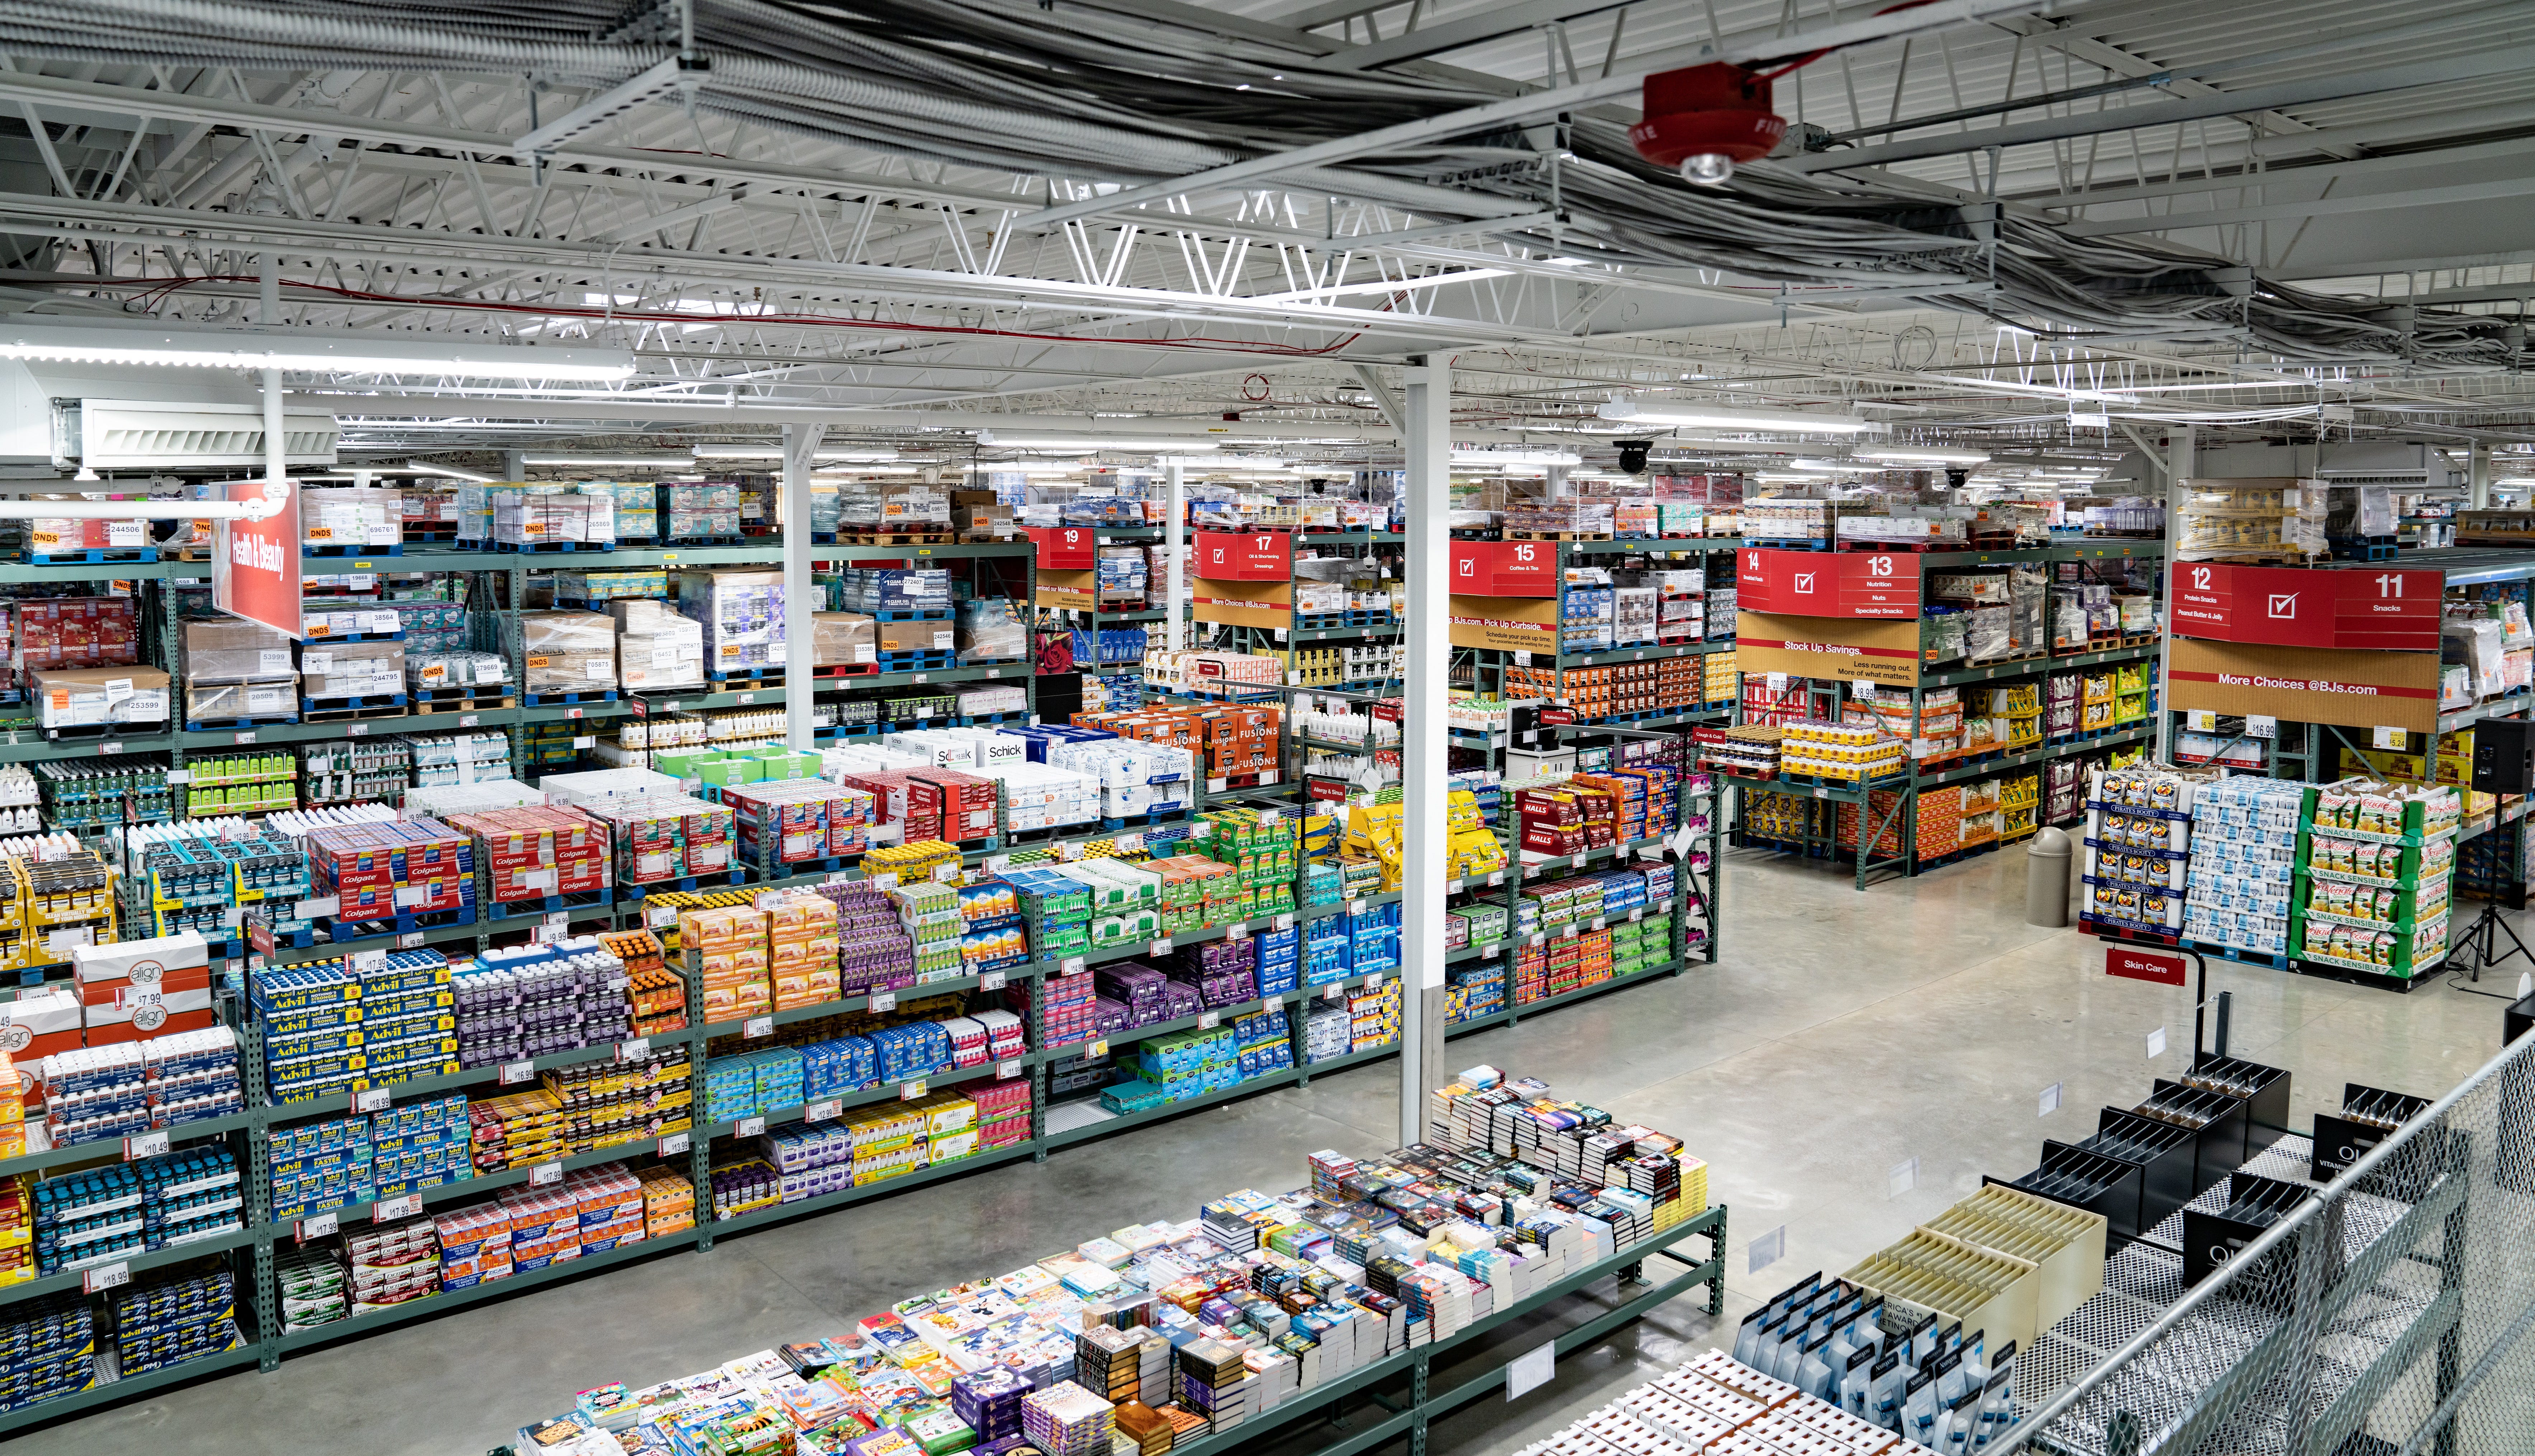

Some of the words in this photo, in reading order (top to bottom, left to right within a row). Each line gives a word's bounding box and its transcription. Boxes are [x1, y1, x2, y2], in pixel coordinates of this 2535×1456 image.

[34, 533, 57, 542] DNDS
[1064, 530, 1078, 543] 19
[1256, 536, 1272, 550] 17
[232, 532, 252, 566] Health
[253, 534, 259, 568] &
[259, 535, 284, 581] Beauty
[1514, 545, 1534, 561] 15
[1748, 552, 1759, 570] 14
[1867, 556, 1892, 576] 13
[2191, 567, 2210, 590] 12
[2376, 574, 2402, 598] 11
[1454, 616, 1482, 626] BJs.com.
[1500, 621, 1509, 629] Up
[1511, 621, 1542, 630] Curbside.
[1784, 641, 1809, 651] Stock
[1811, 643, 1823, 654] Up
[1825, 644, 1862, 656] Savings.
[1519, 656, 1530, 665] $20.99
[1772, 680, 1786, 690] $20.99
[2219, 674, 2250, 686] More
[2254, 676, 2305, 689] Choices
[2309, 680, 2377, 695] @BJs.com
[1858, 688, 1873, 698] $8.99
[1241, 727, 1277, 738] FUSION5
[2253, 724, 2274, 737] $16.99
[990, 745, 1021, 758] Schick
[916, 795, 930, 803] Vitamins
[1525, 805, 1547, 813] HALLS
[2115, 806, 2135, 815] PIRATE'S
[234, 832, 249, 840] $12.99
[1351, 829, 1367, 839] Ricola
[2323, 828, 2344, 838] SNACK
[2346, 830, 2389, 843] SENSIBLE
[1124, 842, 1135, 850] $50.99
[50, 852, 67, 861] $12.99
[412, 866, 444, 875] Colgate
[996, 862, 1008, 872] $41.49
[366, 958, 385, 970] $17.99
[2124, 960, 2143, 970] Skin
[2146, 963, 2167, 973] Care
[131, 966, 161, 982] align
[273, 995, 306, 1009] Advil
[880, 1001, 894, 1010] $33.79
[757, 1024, 771, 1035] $19.29
[1317, 1049, 1341, 1060] NeilMed
[665, 1057, 685, 1066] Airborne
[515, 1069, 532, 1080] $16.99
[370, 1097, 389, 1109] $18.99
[145, 1141, 167, 1155] $10.49
[314, 1156, 340, 1166] FASTER
[274, 1161, 301, 1173] Advil
[784, 1163, 808, 1173] Dimetapp
[275, 1169, 301, 1177] LIQUI-GELS
[317, 1222, 337, 1235] $17.99
[488, 1235, 507, 1243] ZICAM
[104, 1271, 127, 1286] $18.99
[286, 1281, 312, 1290] EXCEDRIN
